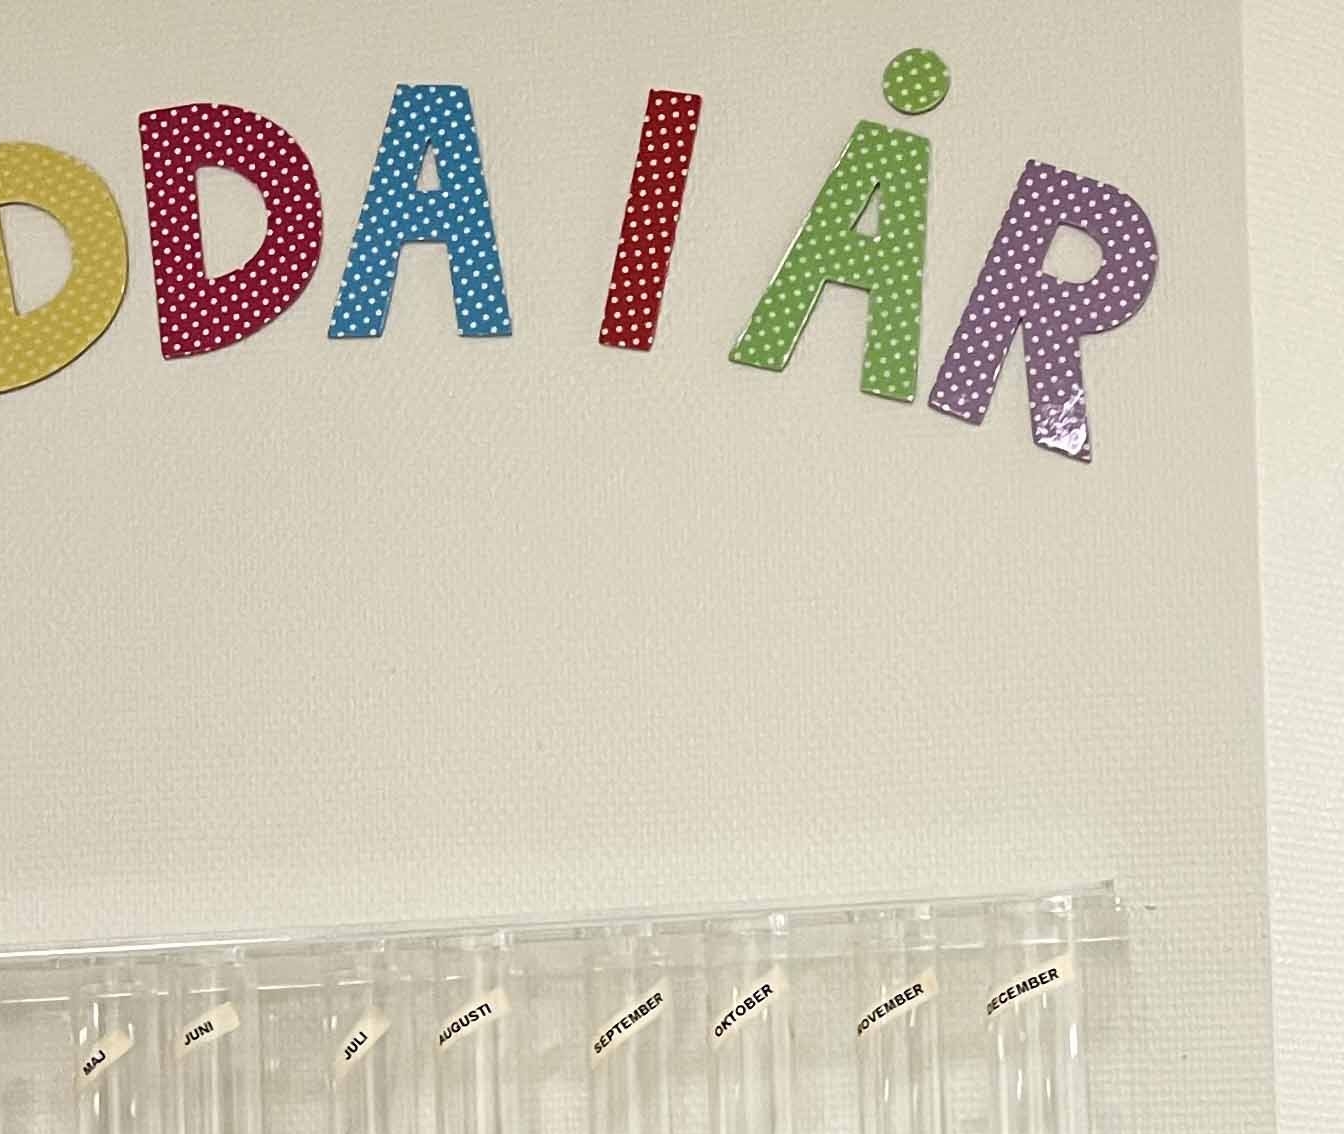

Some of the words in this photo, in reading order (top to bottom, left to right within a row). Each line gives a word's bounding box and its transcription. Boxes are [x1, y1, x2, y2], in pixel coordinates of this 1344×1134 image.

[598, 88, 703, 352] I
[729, 48, 1159, 463] ÅR
[439, 1003, 492, 1046] AUGUSTI
[593, 992, 664, 1054] SEPTEMBER
[714, 983, 774, 1038] OKTOBER
[184, 1020, 214, 1046] JUNI
[344, 1031, 368, 1061] JULI
[82, 1049, 106, 1076] MAJ
